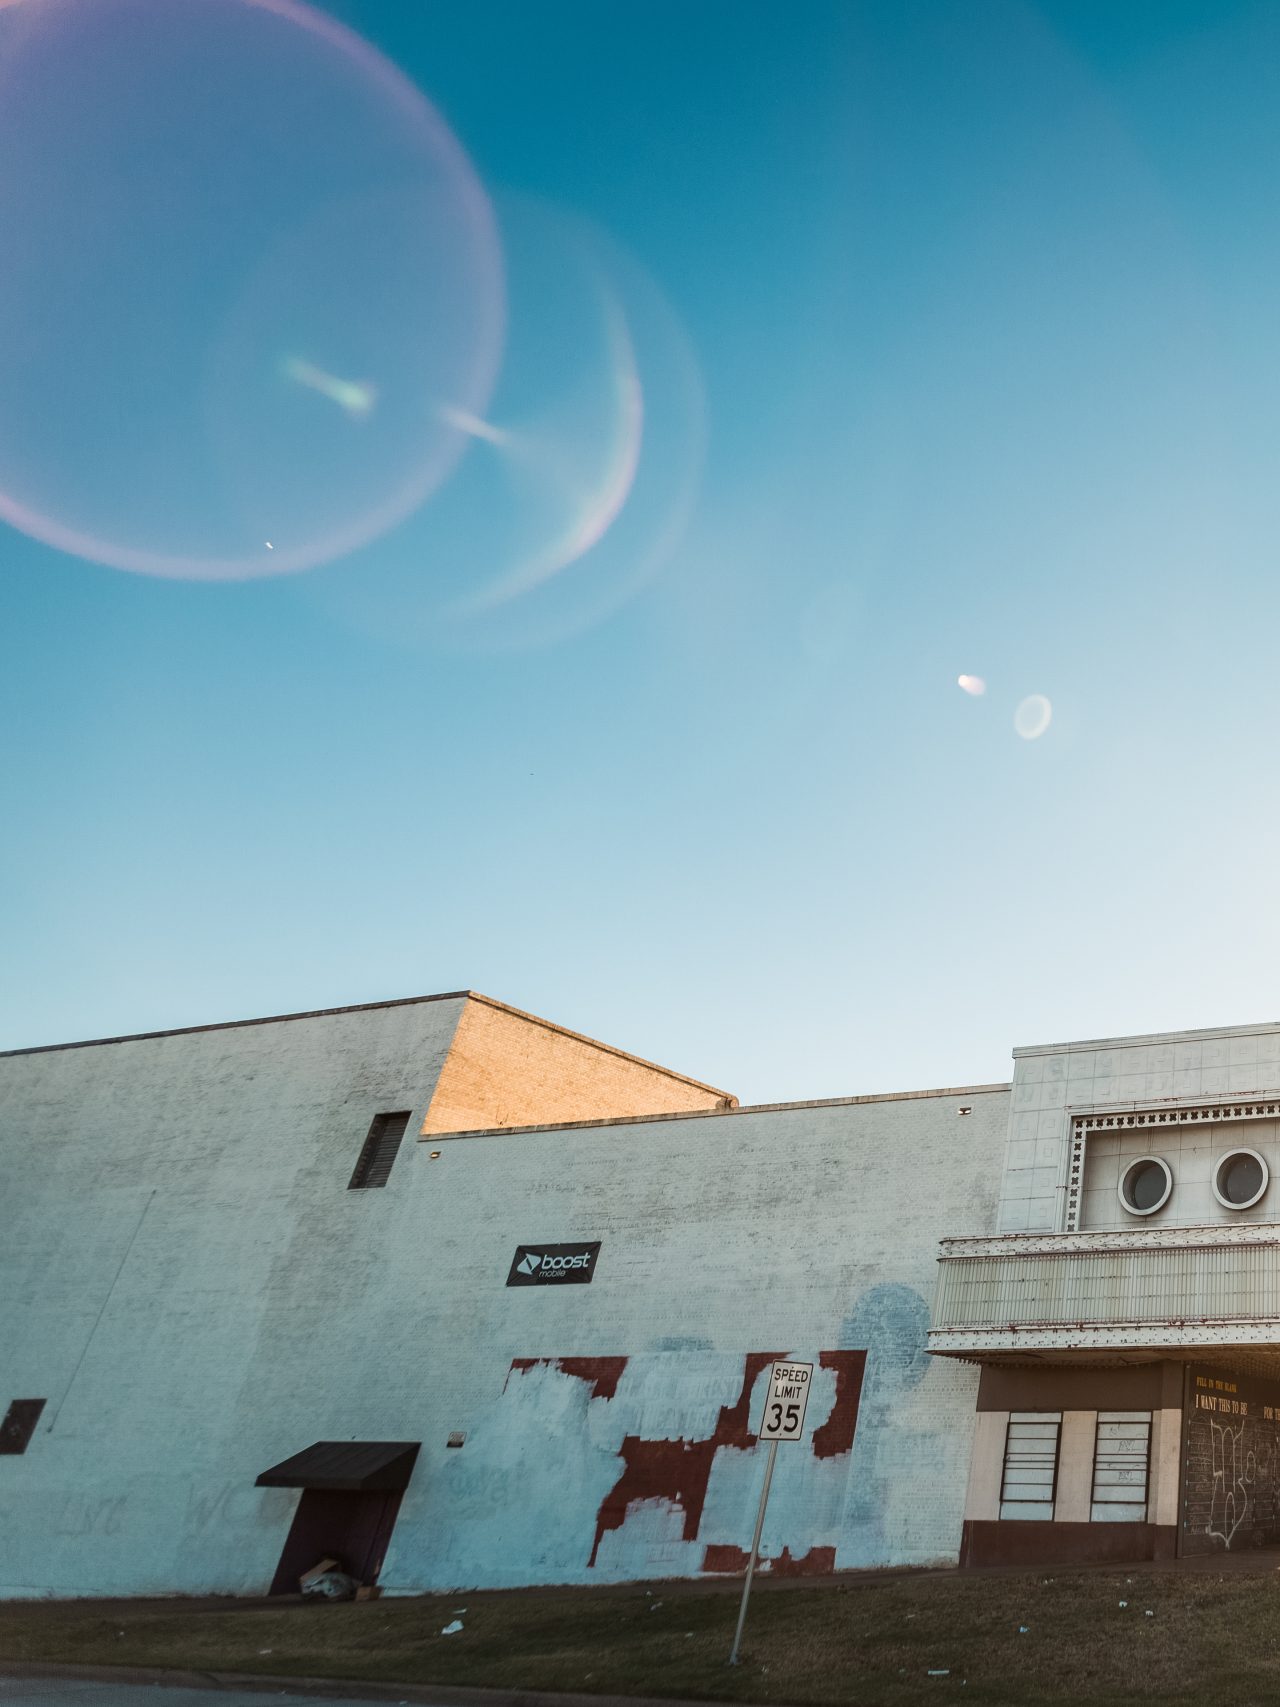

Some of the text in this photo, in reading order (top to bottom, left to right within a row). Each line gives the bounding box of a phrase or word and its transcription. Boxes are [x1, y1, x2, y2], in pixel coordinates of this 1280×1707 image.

[541, 1252, 591, 1269] boost
[539, 1269, 566, 1278] mobile
[774, 1368, 808, 1382] SPEED
[774, 1386, 802, 1399] LIMIT
[1195, 1394, 1199, 1409] I
[1200, 1395, 1217, 1411] WANT
[1218, 1398, 1231, 1413] THIS
[1232, 1400, 1239, 1414] TO
[1240, 1402, 1248, 1416] BE
[766, 1403, 800, 1432] 35
